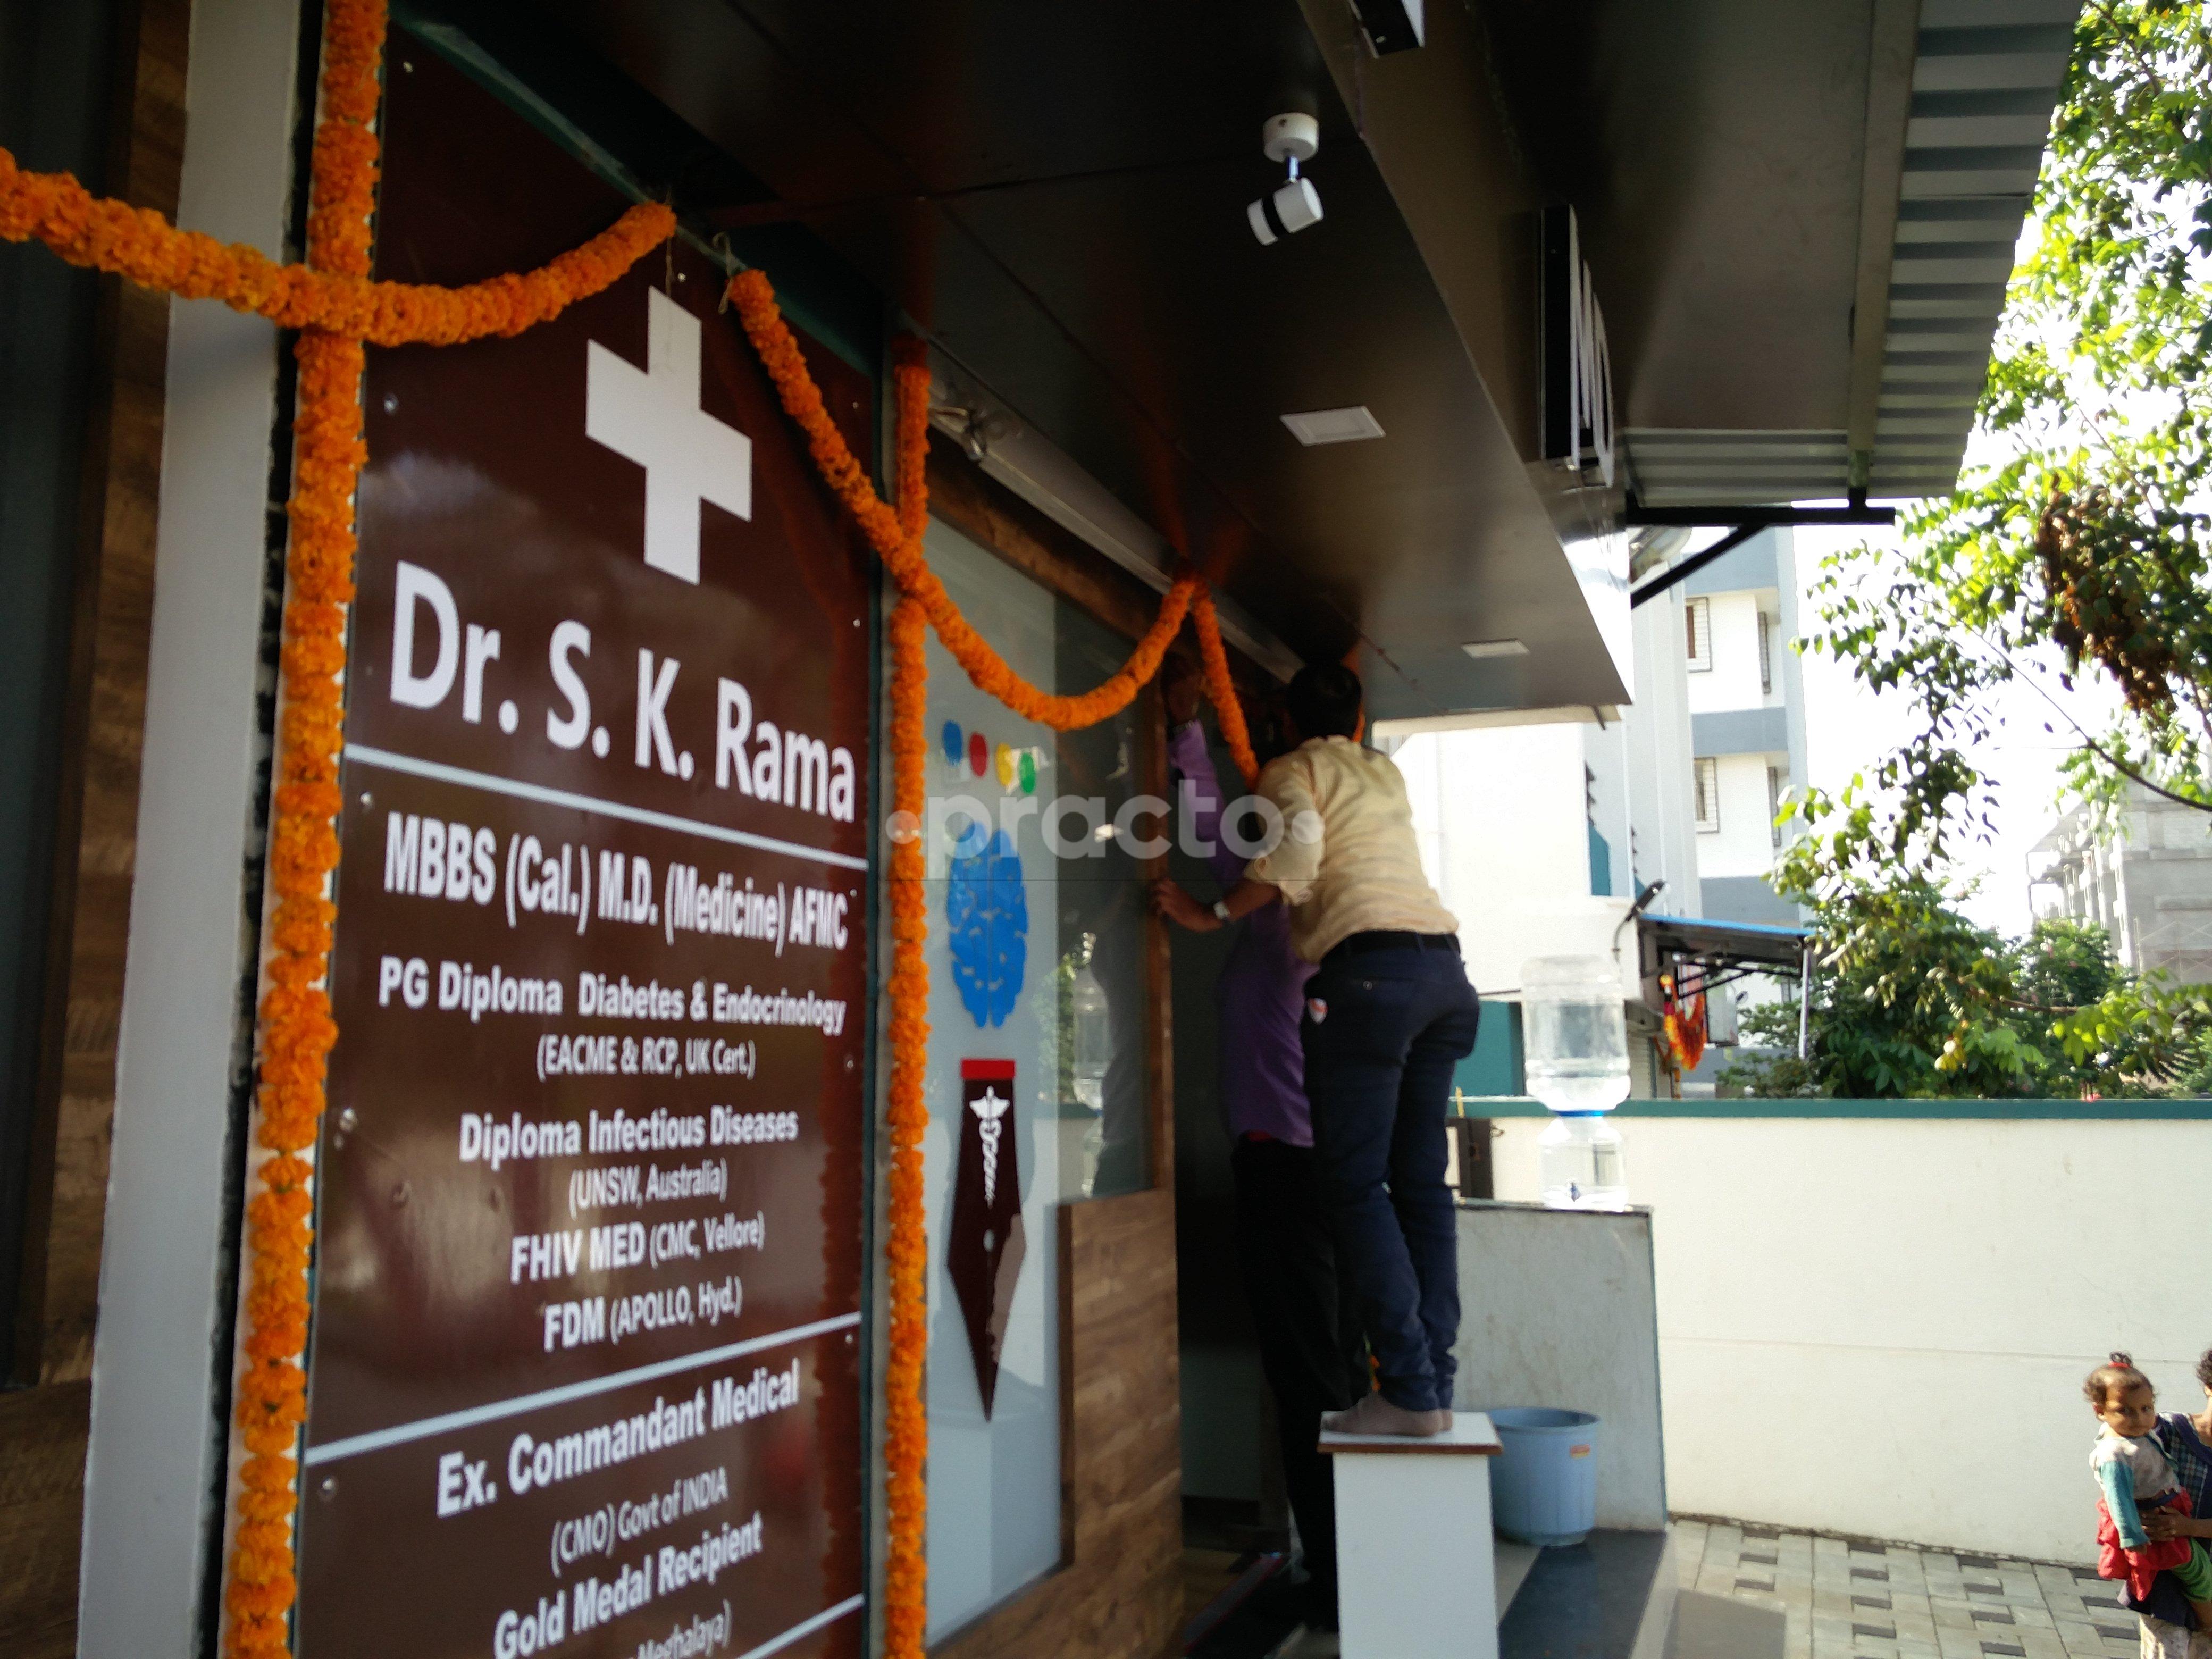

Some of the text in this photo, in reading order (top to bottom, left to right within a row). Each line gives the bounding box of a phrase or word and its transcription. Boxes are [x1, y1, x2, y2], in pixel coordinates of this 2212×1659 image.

[390, 559, 854, 822] Dr. S. K. Rama
[384, 811, 848, 958] MBBS (Cal.) M.D. (Medicine) AFMC
[378, 956, 846, 1036] PG Diploma Diabetes & Endocrinology
[537, 1034, 756, 1083] (EACME & RCP, UK Cert.)
[459, 1104, 798, 1171] Diploma Infectious Diseases
[569, 1157, 727, 1221] (UNSW, Australia)
[510, 1210, 765, 1285] FHIV MED (CMC, Vellore)
[543, 1276, 742, 1353] FDM (APOLLO, Hyd.)
[436, 1357, 800, 1518] Ex. Commandant Medical
[551, 1466, 729, 1579] (CMO) Govt of INDIA
[493, 1510, 763, 1659] Gold Medal Recipient
